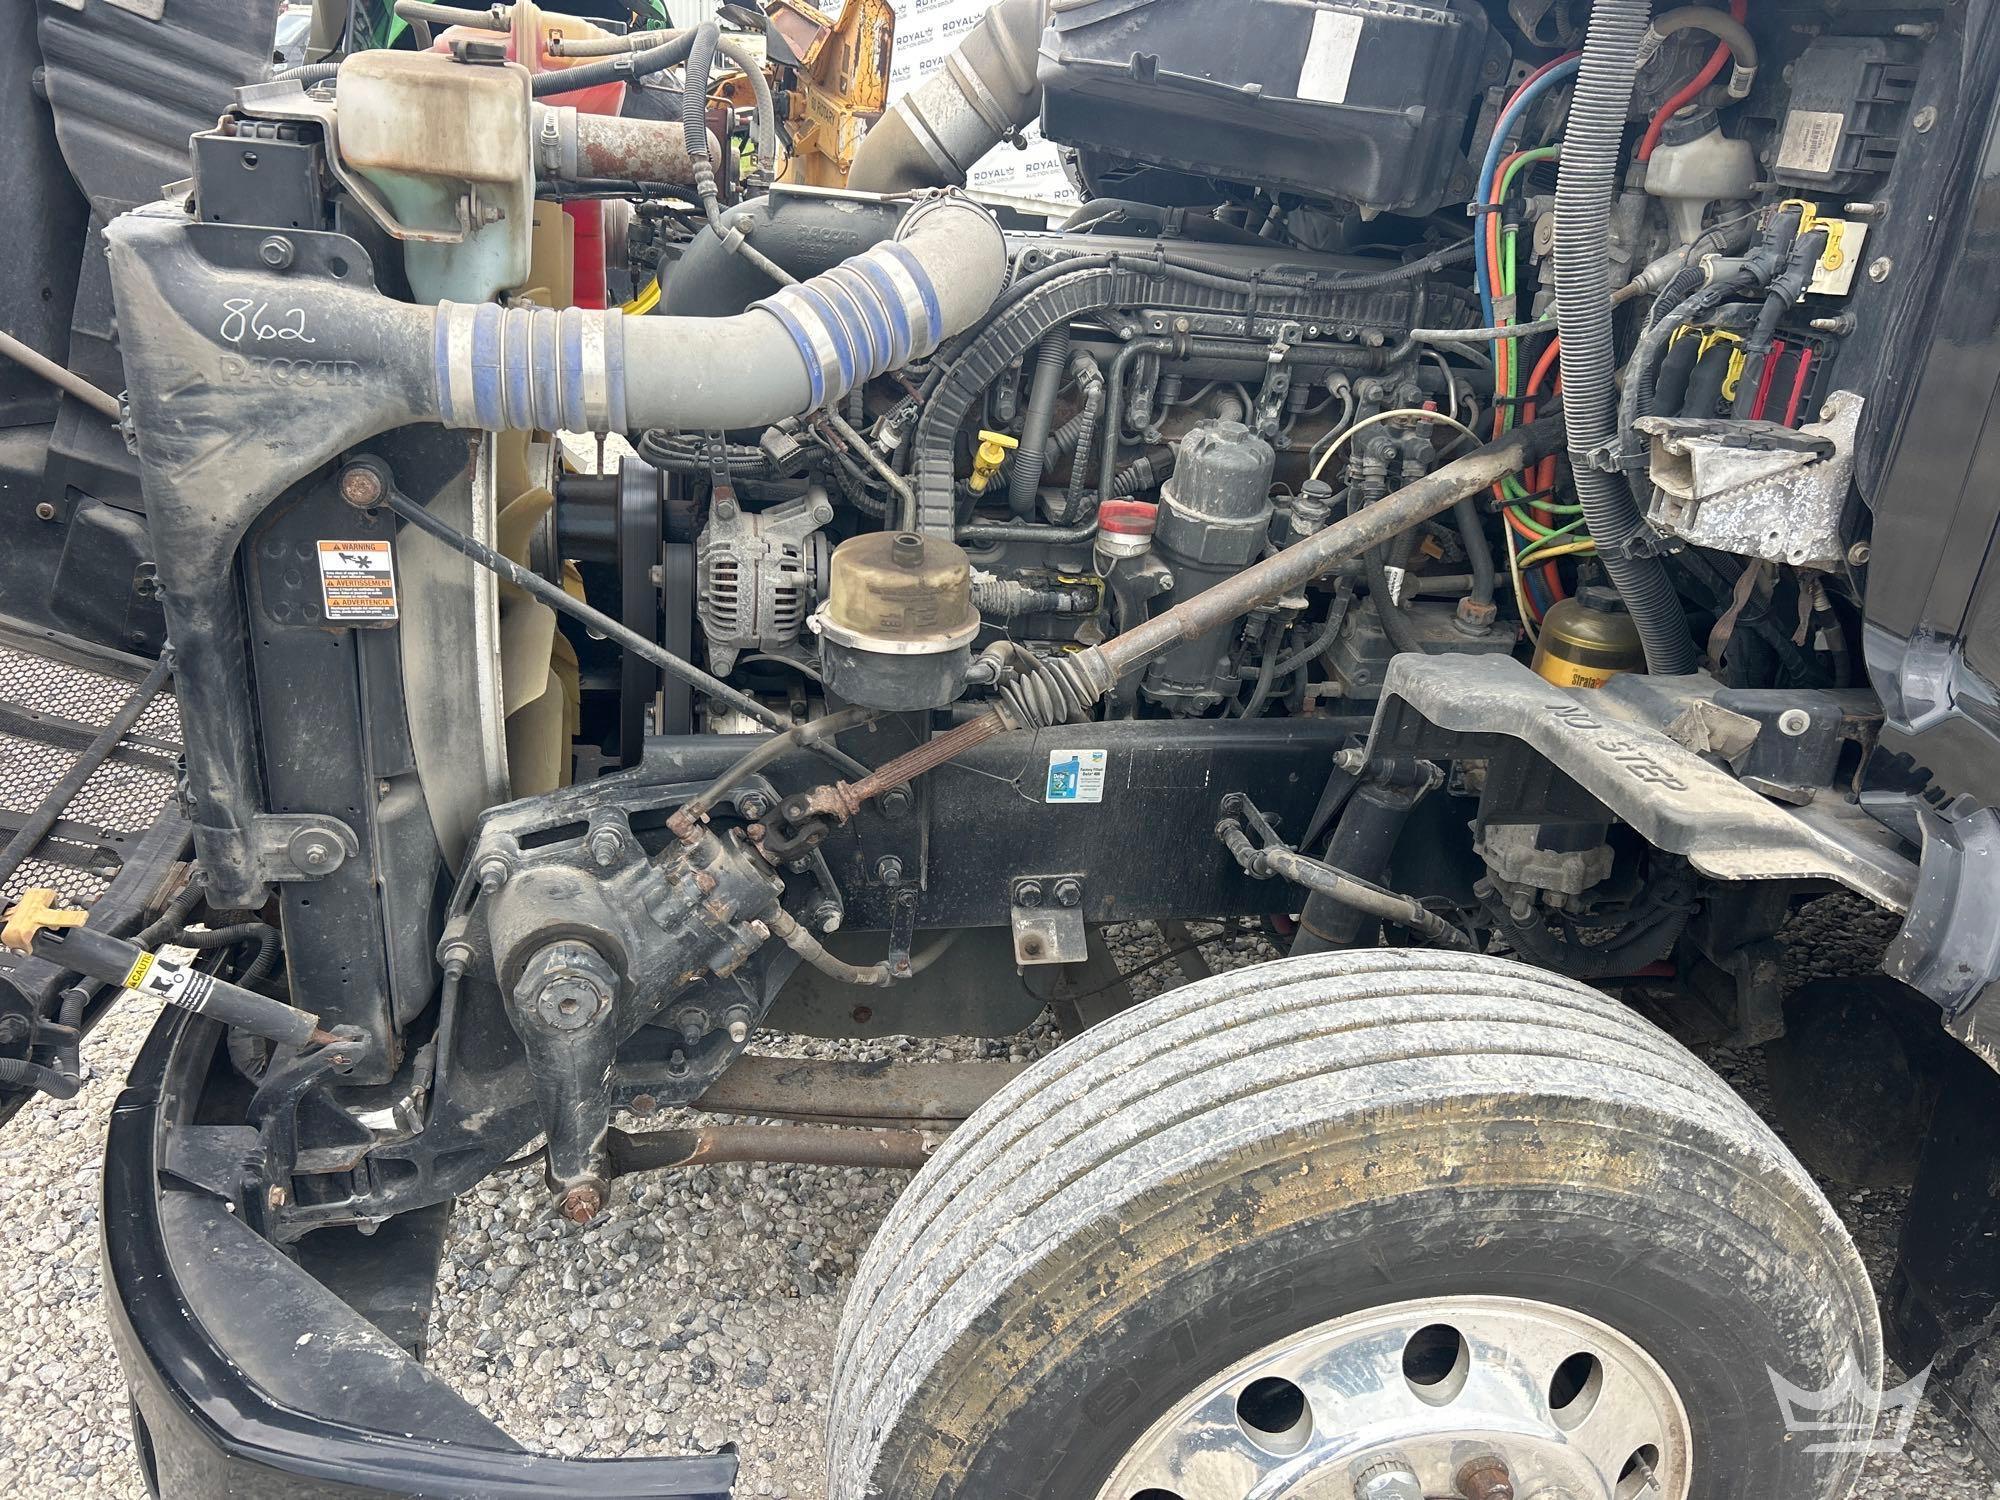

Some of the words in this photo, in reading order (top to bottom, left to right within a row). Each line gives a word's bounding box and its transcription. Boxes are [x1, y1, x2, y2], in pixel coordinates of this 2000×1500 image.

[942, 15, 975, 32] ROYAL
[896, 31, 925, 46] ROYAL
[919, 56, 944, 70] ROYA
[1025, 159, 1060, 172] ROYAL
[974, 168, 1006, 180] ROYAL
[220, 298, 316, 343] 862
[219, 354, 365, 388] PACCAR
[341, 543, 376, 551] WARNING
[336, 578, 390, 587] AVERTISSEMENT
[342, 599, 390, 607] ADVERTENCIA
[1544, 704, 1602, 730] NO
[1596, 740, 1689, 792] STEP
